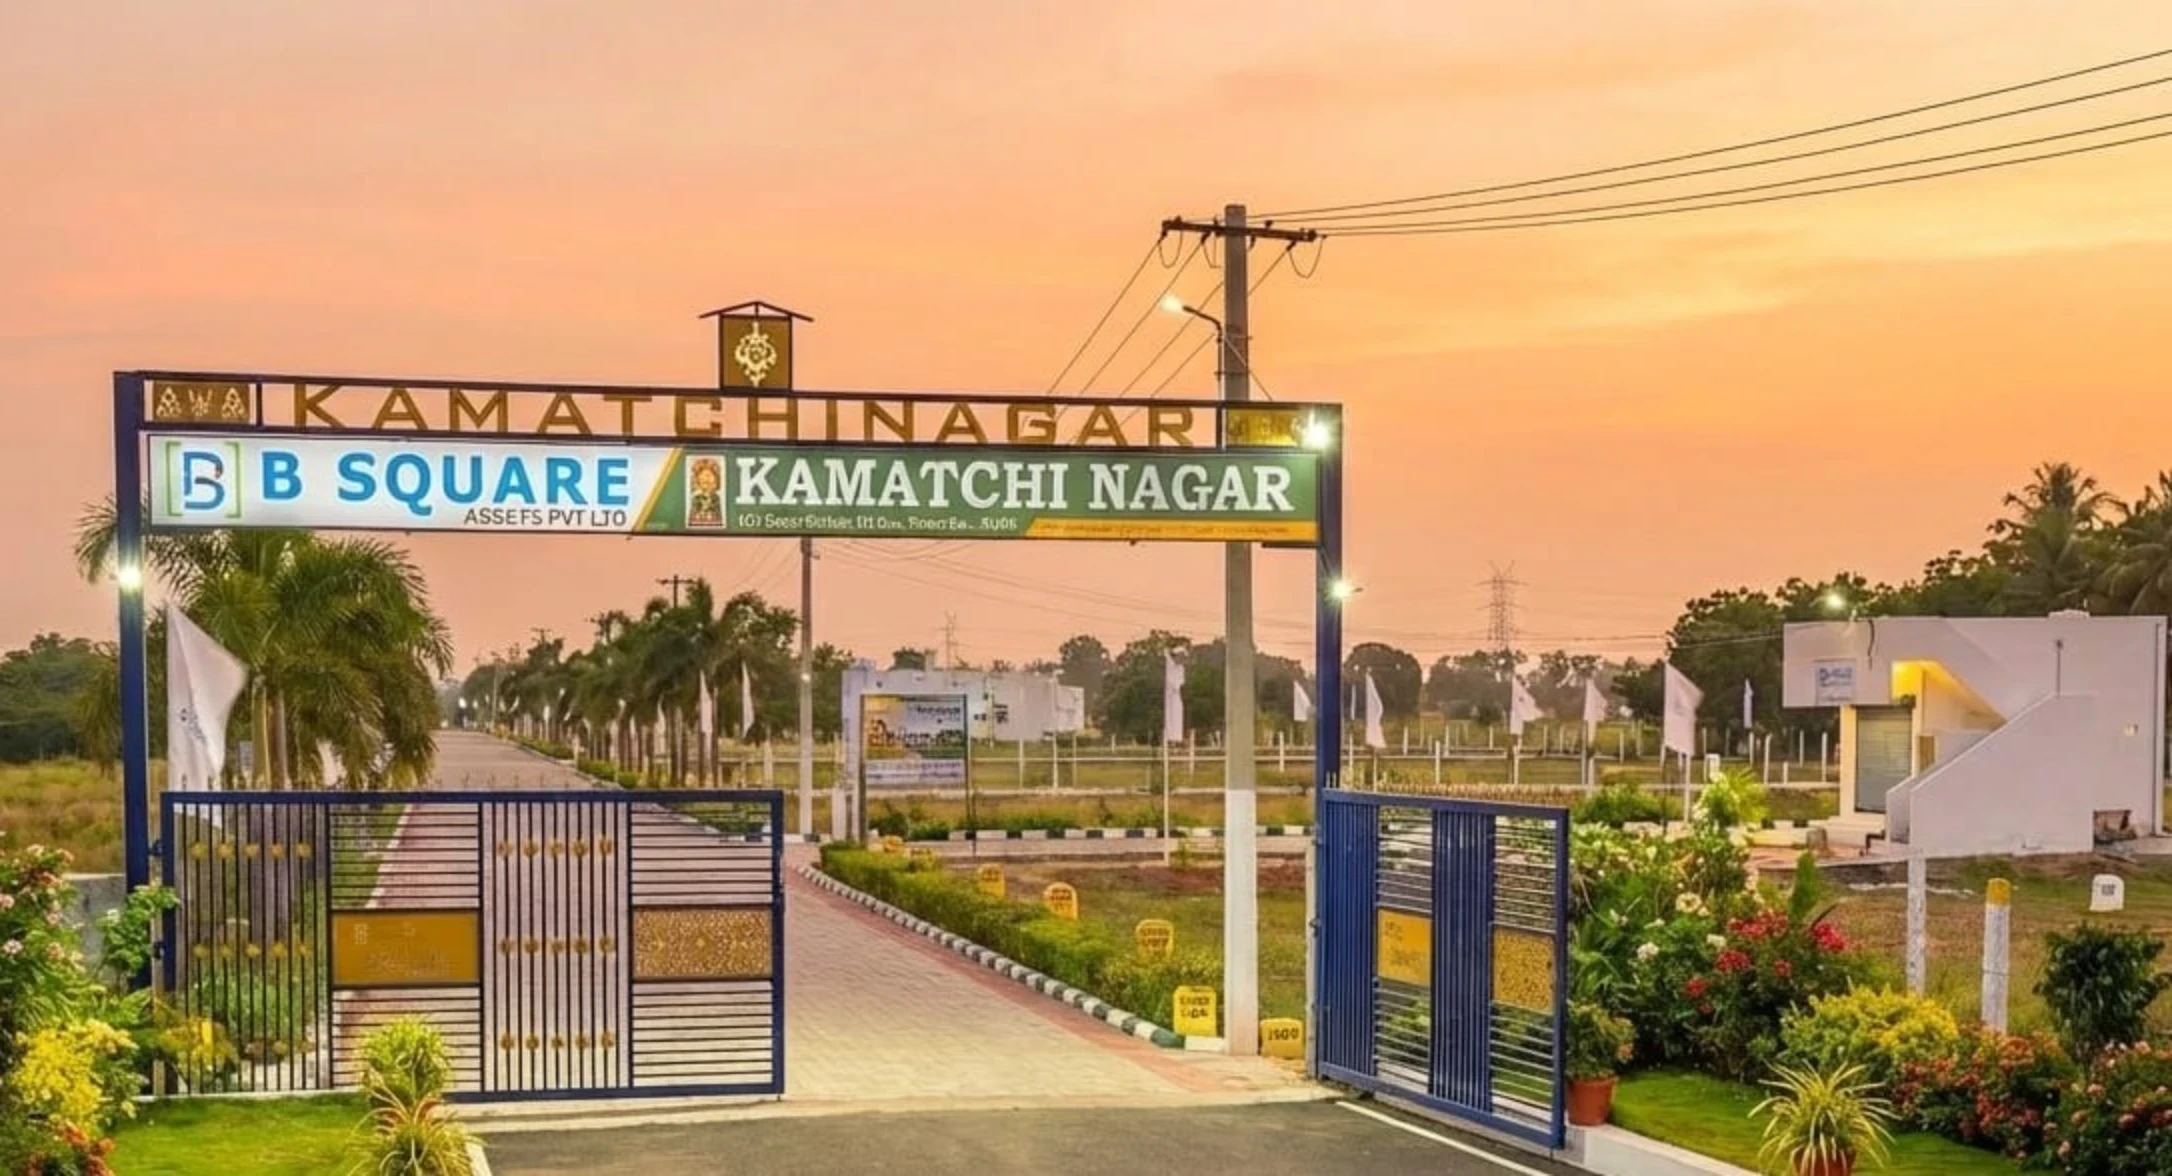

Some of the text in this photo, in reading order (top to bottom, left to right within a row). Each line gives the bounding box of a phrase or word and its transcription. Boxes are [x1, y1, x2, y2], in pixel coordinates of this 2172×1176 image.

[261, 451, 630, 516] B SQUARE
[735, 456, 1295, 511] KAMATCHI NAGAR
[549, 508, 586, 525] PVT
